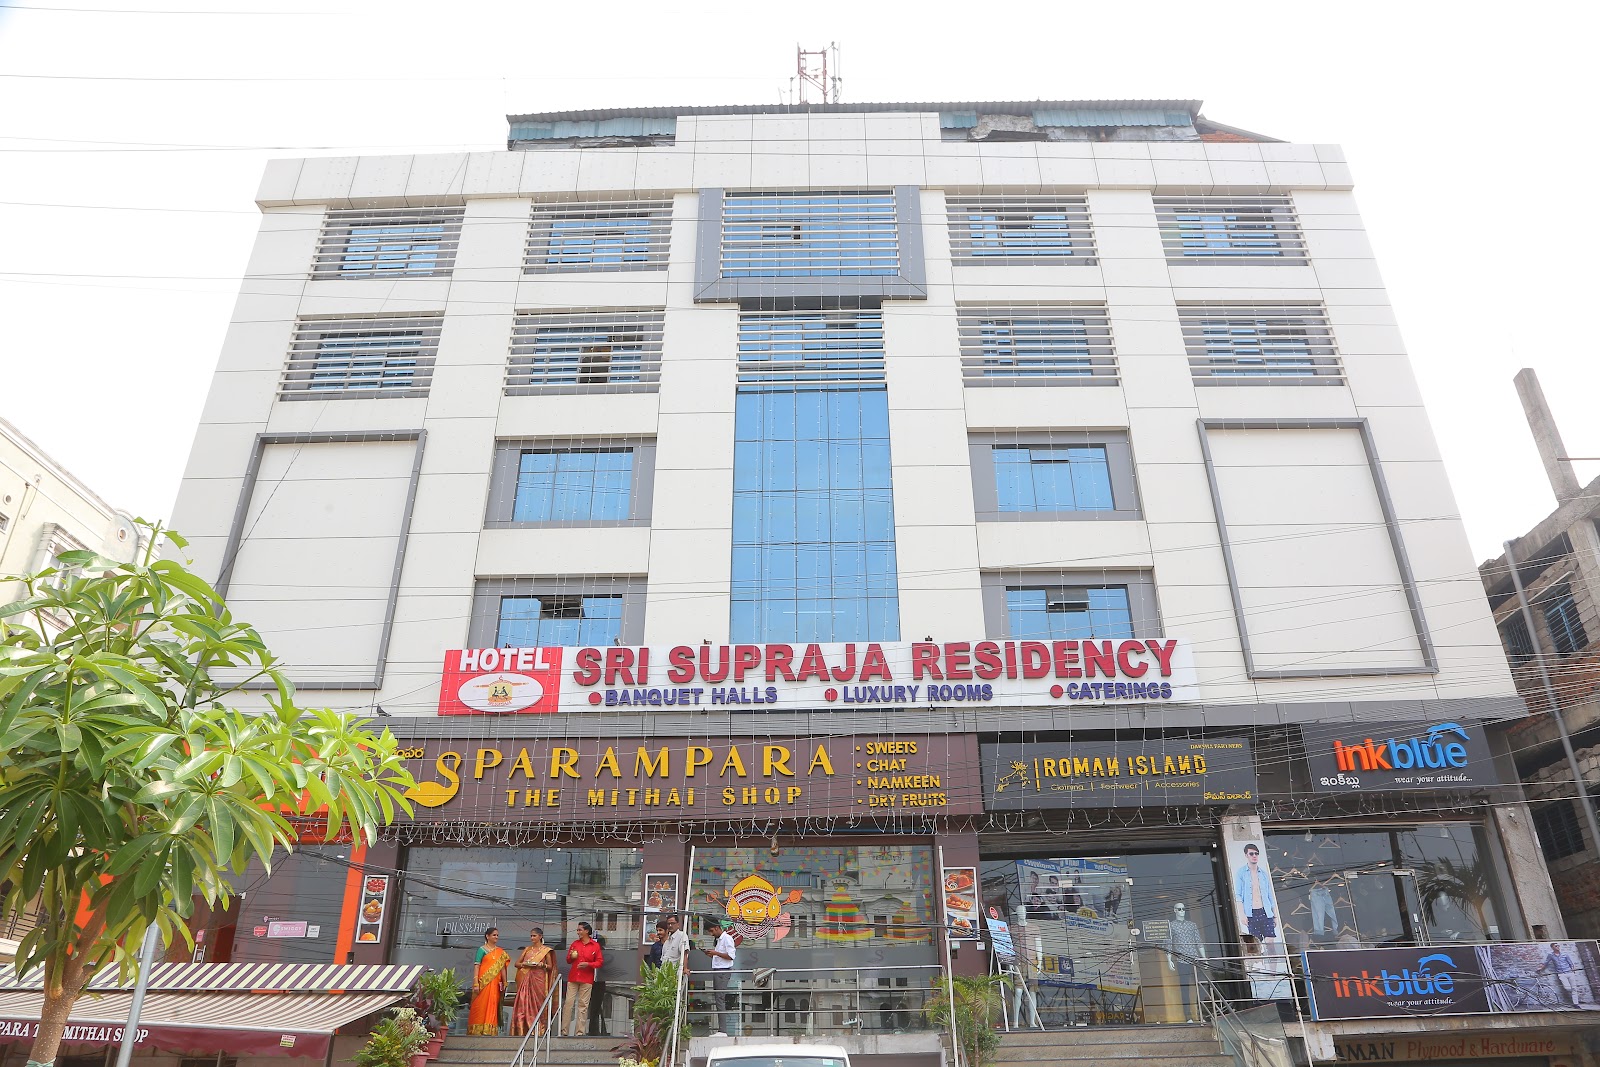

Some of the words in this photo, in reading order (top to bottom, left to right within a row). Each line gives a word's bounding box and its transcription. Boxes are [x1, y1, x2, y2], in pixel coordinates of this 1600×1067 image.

[459, 648, 551, 672] HOTEL
[573, 646, 650, 686] SRI
[668, 643, 893, 683] SUPRAJA
[912, 640, 1178, 681] RESIDENCY
[605, 688, 704, 707] BANQUET
[711, 686, 778, 705] HALLS
[843, 684, 920, 703] LUXURY
[927, 683, 993, 702] ROOMS
[1067, 682, 1172, 700] CATERINGS
[866, 741, 918, 755] SWEETS
[1333, 737, 1469, 771] inkblue
[474, 744, 834, 780] PARAMPARA
[867, 759, 907, 772] CHAT
[1043, 757, 1120, 778] ROMAN
[1127, 754, 1207, 776] ISLAND
[868, 775, 940, 790] NAMKEEN
[1395, 776, 1414, 784] wear
[1416, 775, 1435, 785] your
[506, 789, 560, 807] THE
[722, 786, 802, 806] SHOP
[869, 794, 898, 808] DRY
[903, 792, 947, 807] FRUITS
[1332, 968, 1454, 998] inkblue
[1406, 999, 1423, 1009] your
[62, 1025, 112, 1041] MITHAI
[1407, 1040, 1465, 1060] Plywood
[1469, 1043, 1478, 1057] &
[1481, 1037, 1555, 1056] Hardware
